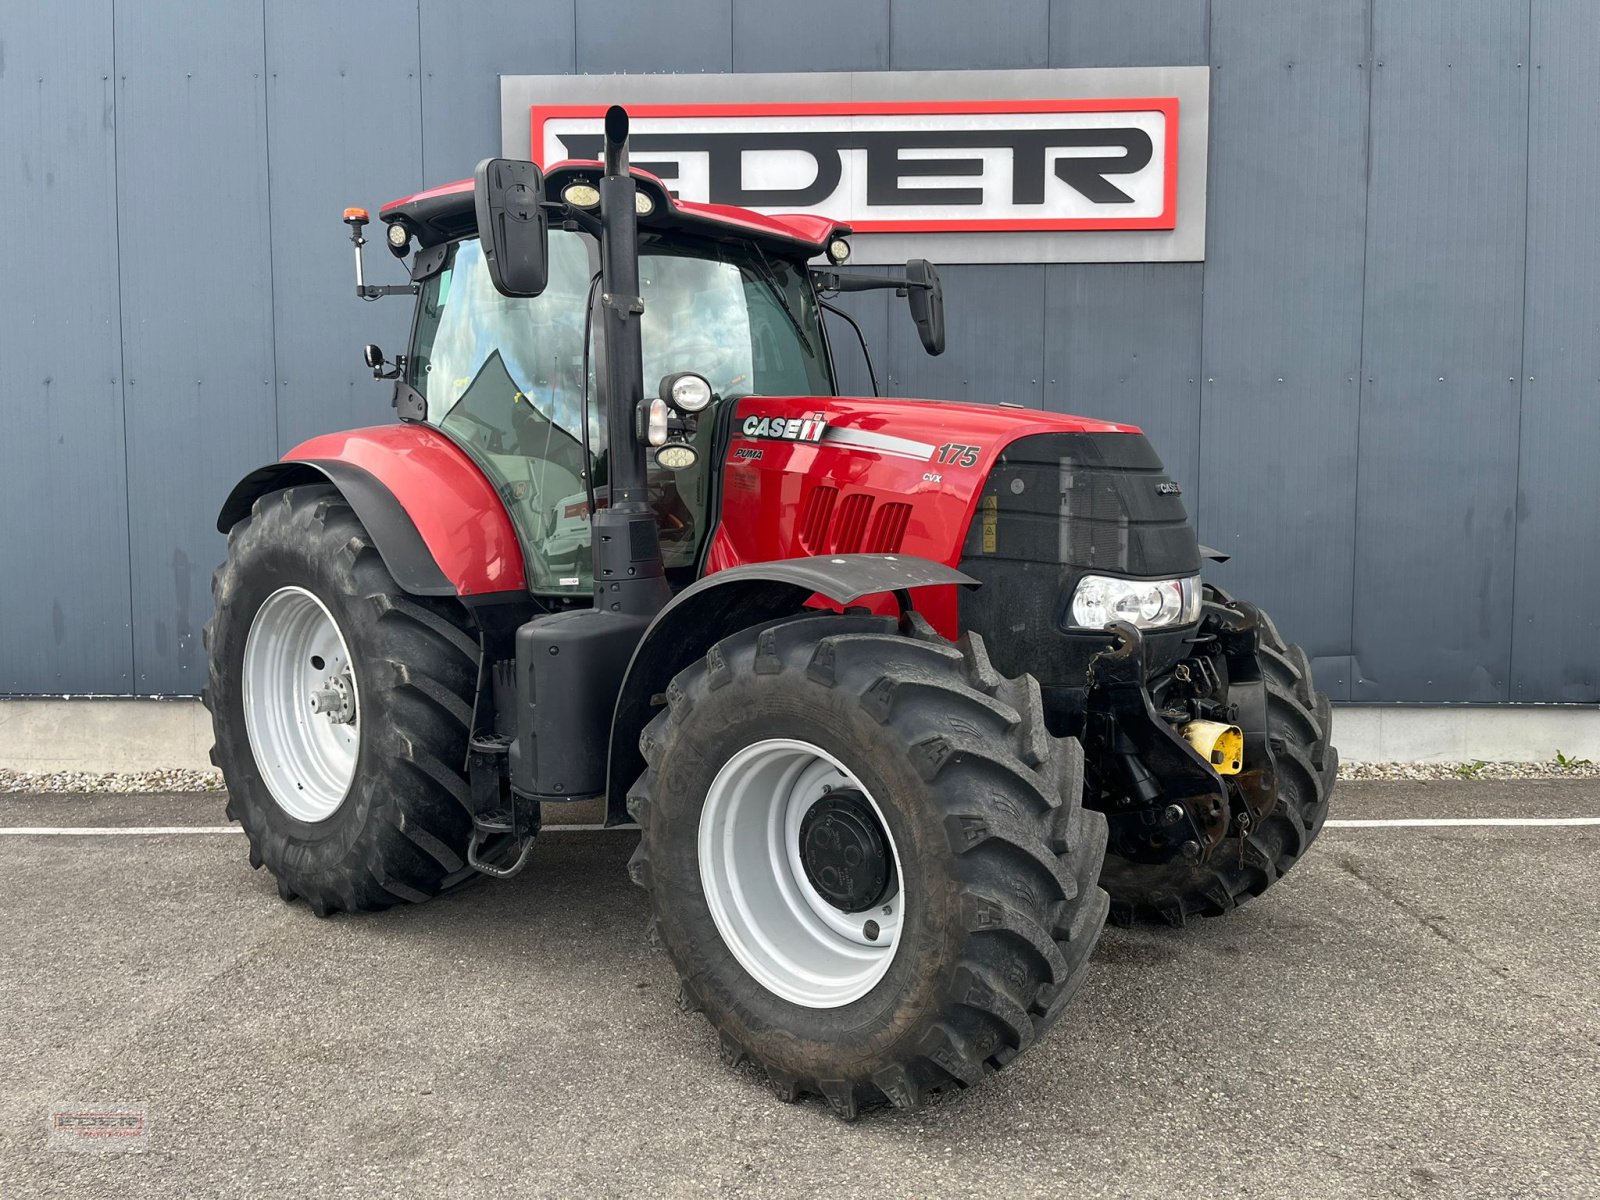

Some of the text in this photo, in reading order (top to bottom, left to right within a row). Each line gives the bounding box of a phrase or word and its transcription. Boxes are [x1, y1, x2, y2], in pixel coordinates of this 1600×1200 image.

[742, 415, 802, 439] CASE
[735, 448, 763, 459] PUMA
[937, 442, 981, 467] 175
[922, 472, 942, 483] CVX
